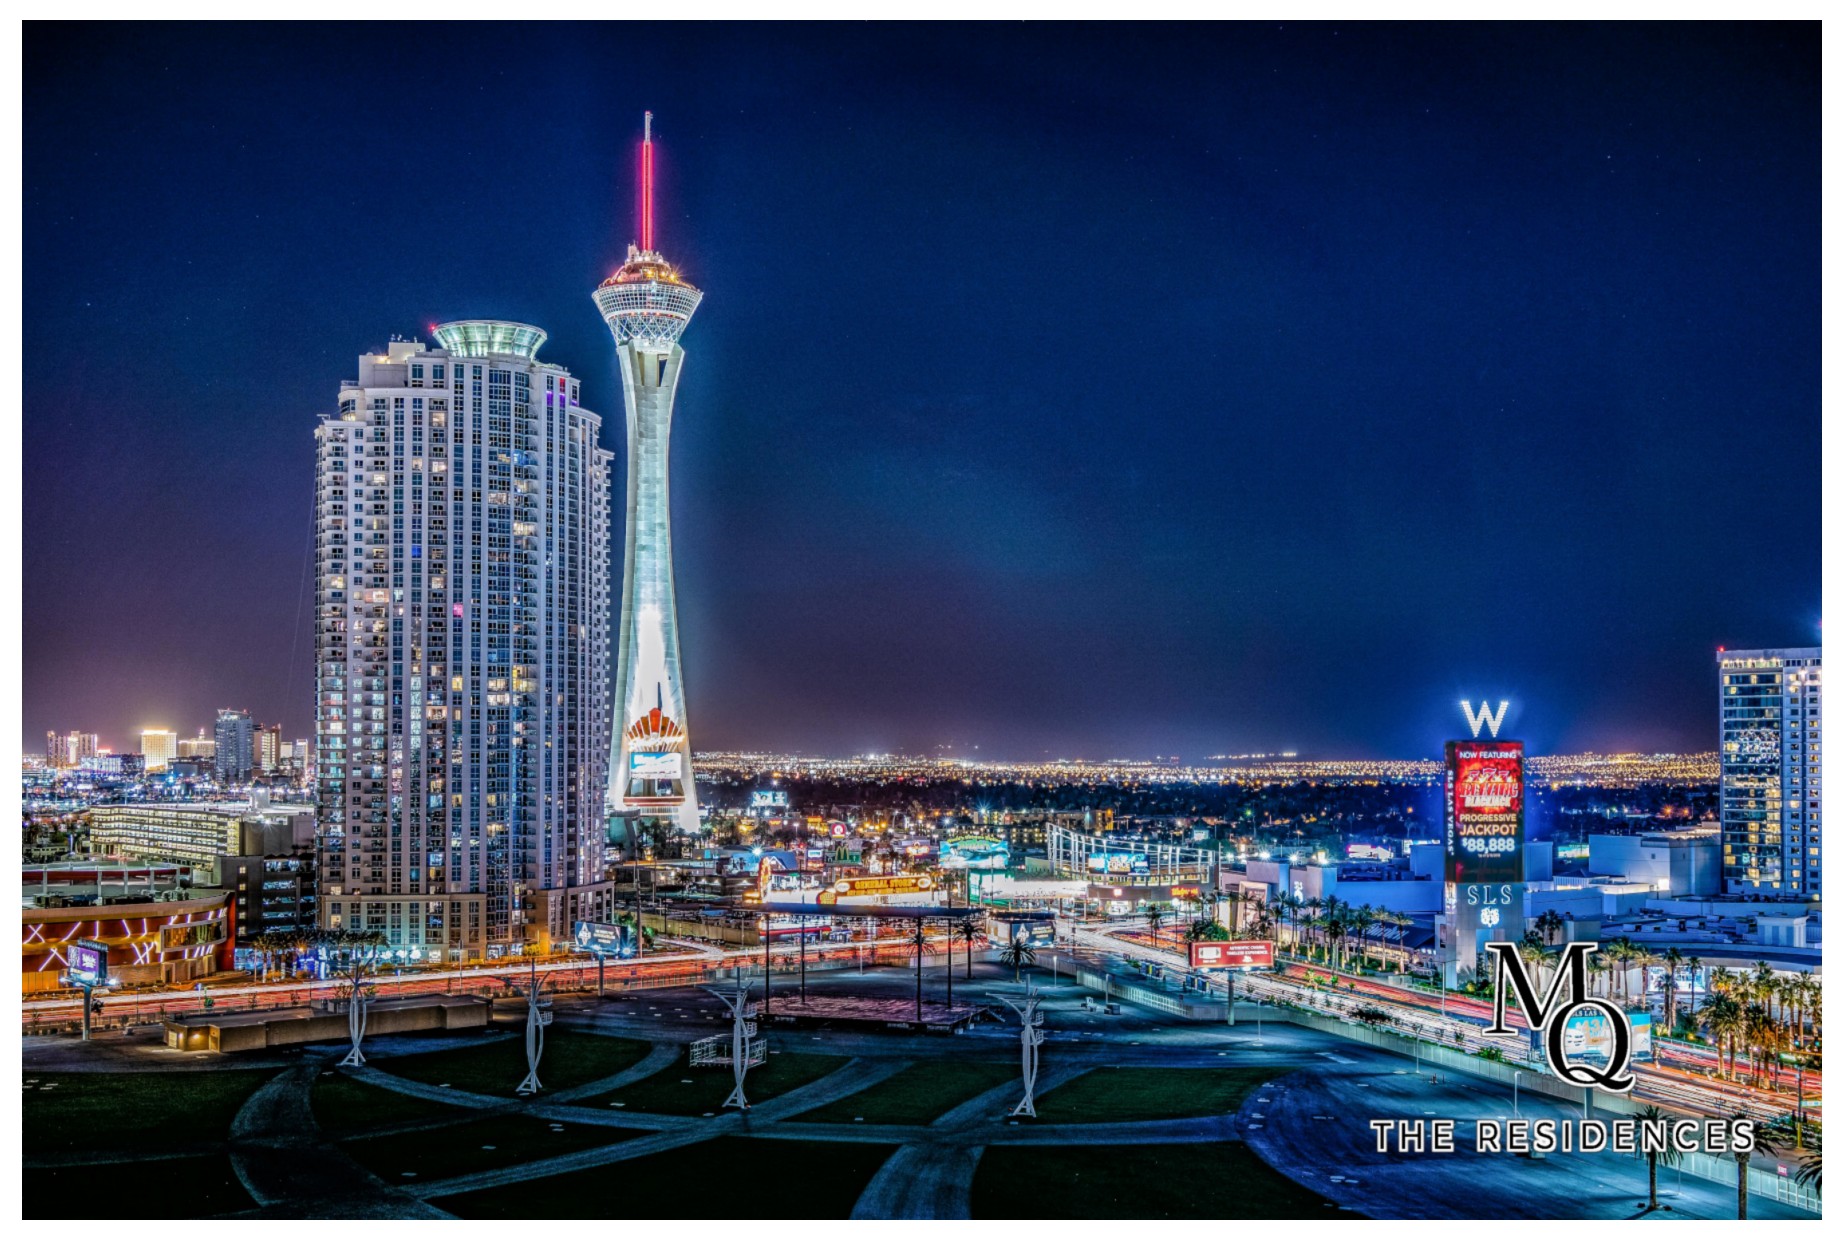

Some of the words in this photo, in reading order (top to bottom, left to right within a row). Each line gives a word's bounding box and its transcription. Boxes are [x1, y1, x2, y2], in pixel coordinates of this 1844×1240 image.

[1461, 700, 1509, 738] W
[1460, 751, 1477, 759] NOW
[1480, 751, 1517, 759] FEATURING
[1459, 813, 1517, 822] PROGRESSIVE
[1459, 824, 1517, 836] JACKPOT
[1462, 837, 1516, 854] $88,888
[1467, 884, 1512, 905] SLS
